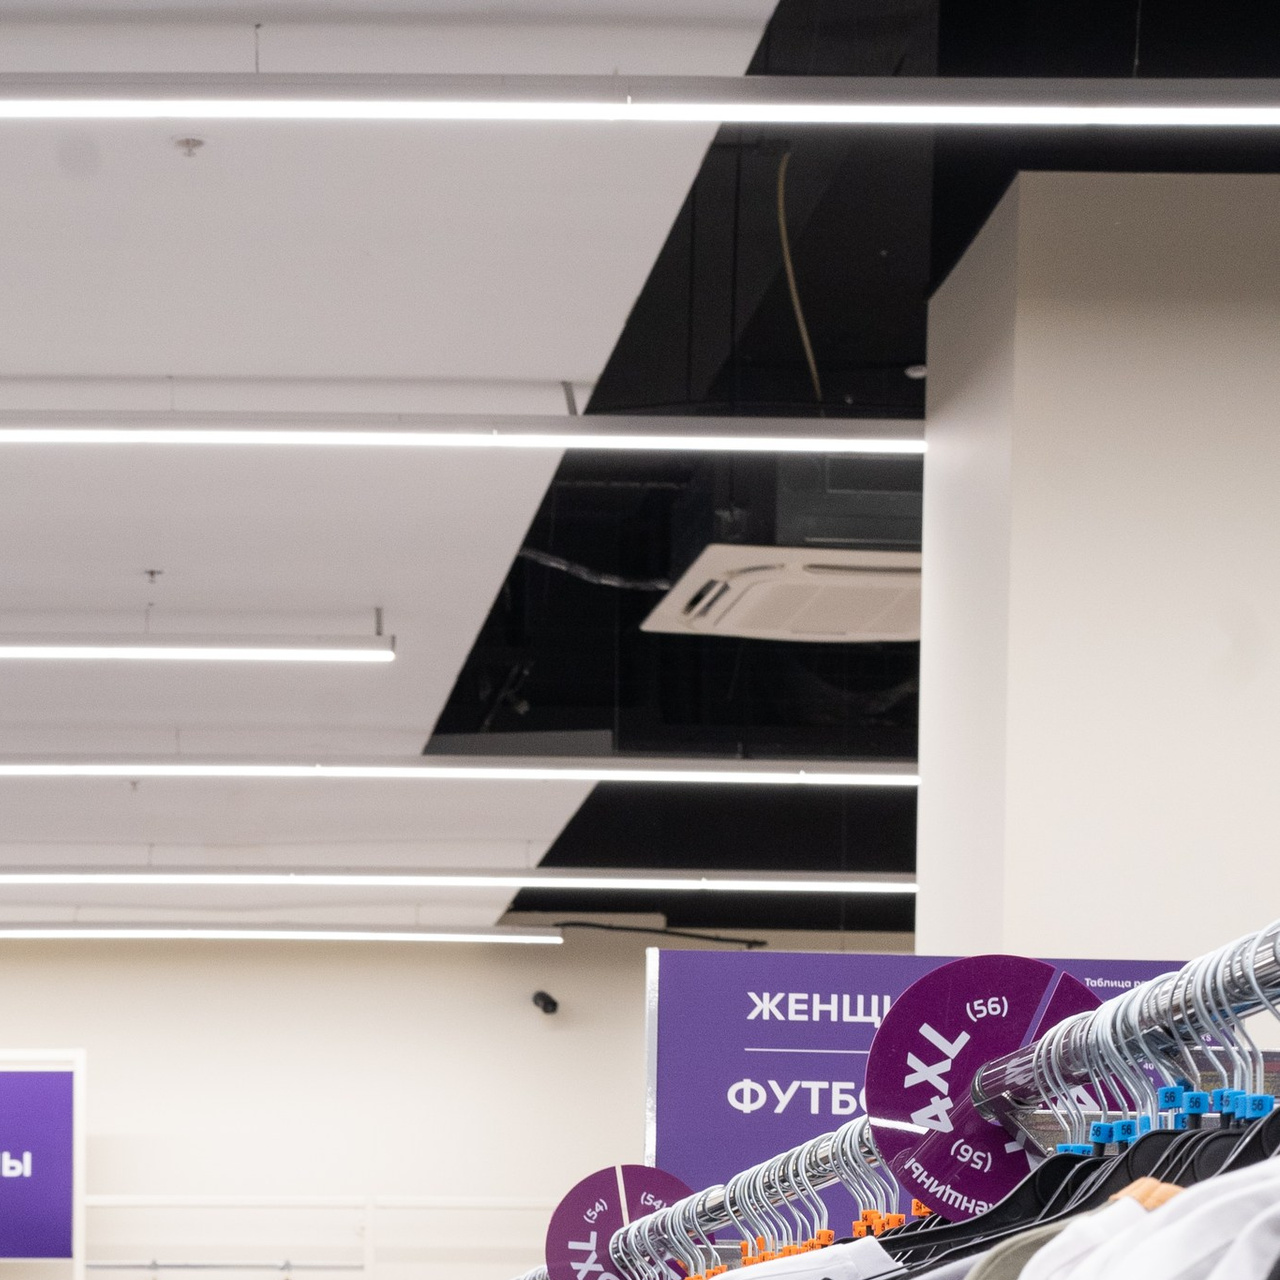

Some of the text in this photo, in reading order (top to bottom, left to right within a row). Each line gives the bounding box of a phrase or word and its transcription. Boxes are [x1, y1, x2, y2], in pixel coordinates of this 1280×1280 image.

[1084, 977, 1132, 988] Таблица
[746, 991, 891, 1029] ЖЕНЩ
[966, 996, 1009, 1022] (56)
[903, 1022, 971, 1133] 4XL
[726, 1078, 867, 1115] ФУТБ
[1164, 1091, 1176, 1103] 56
[1189, 1096, 1201, 1109] 56
[1252, 1099, 1264, 1111] 56
[1091, 1125, 1102, 1138] 56
[1121, 1124, 1132, 1136] 56
[950, 1138, 993, 1173] (56)
[583, 1198, 609, 1224] (54)
